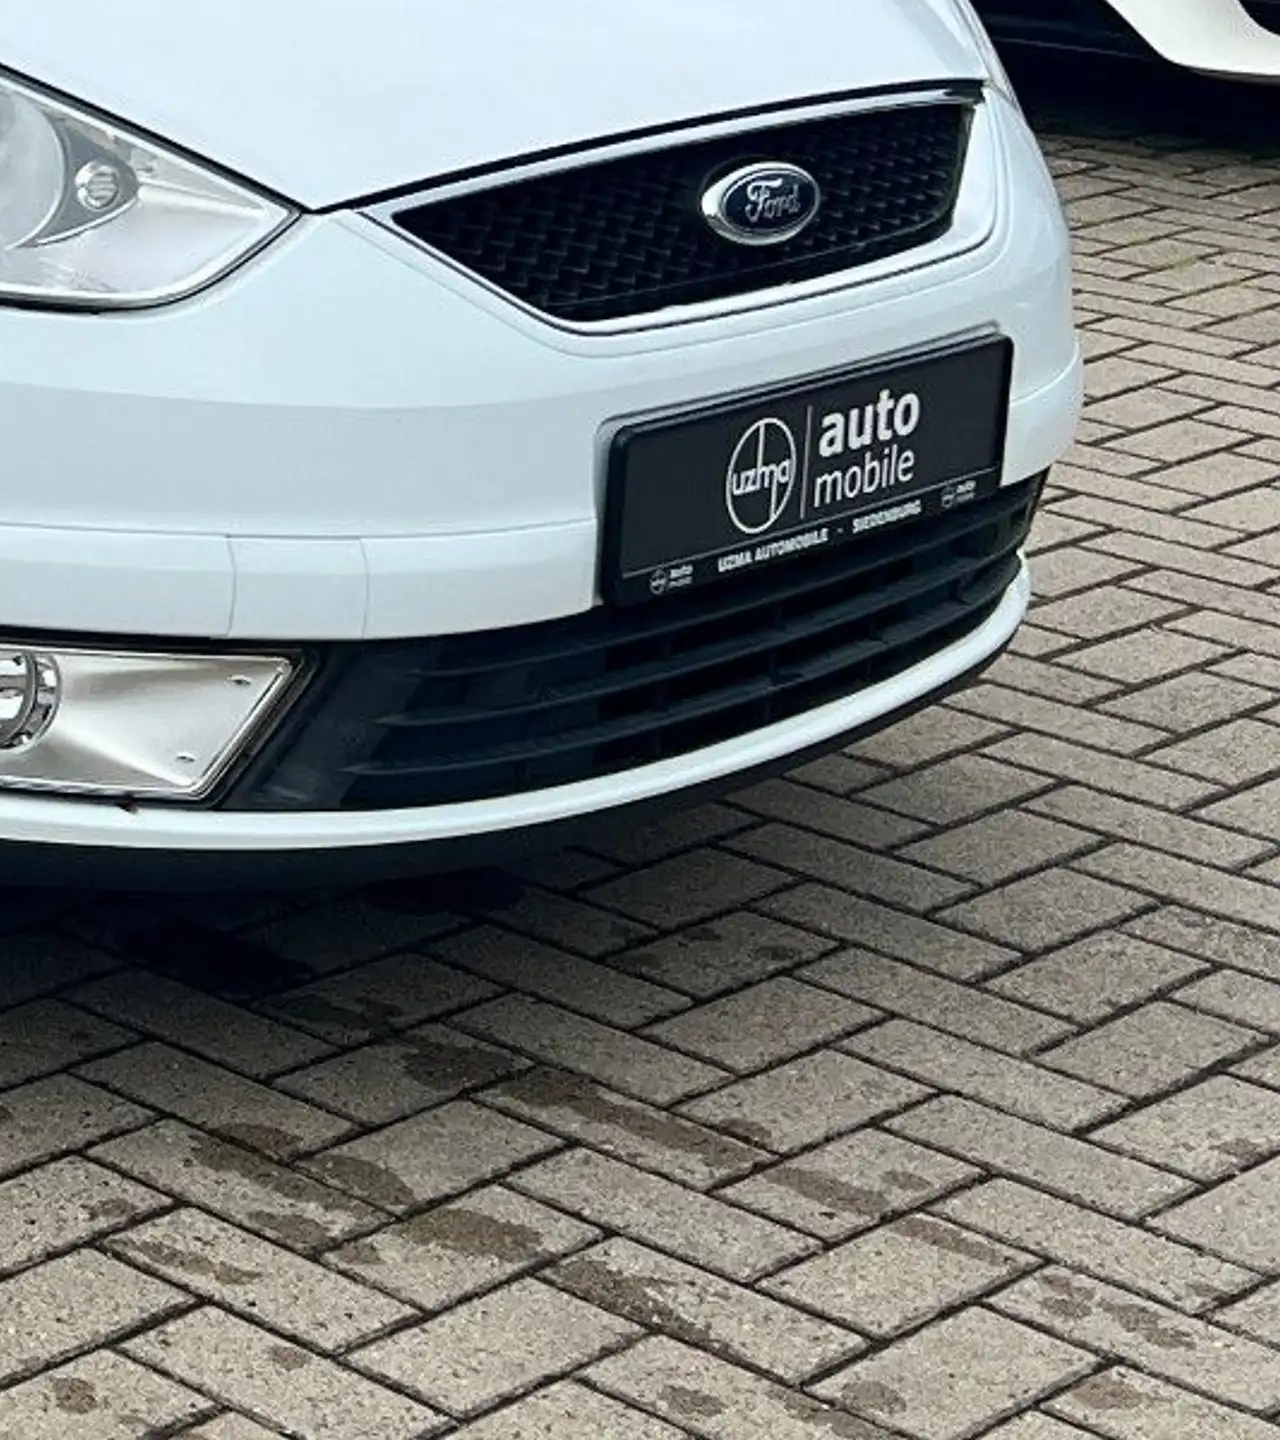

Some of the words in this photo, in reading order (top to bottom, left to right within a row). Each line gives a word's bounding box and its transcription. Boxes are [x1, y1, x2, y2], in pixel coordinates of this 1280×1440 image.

[744, 177, 801, 224] Ford
[819, 389, 920, 457] auto
[814, 444, 915, 508] mobile
